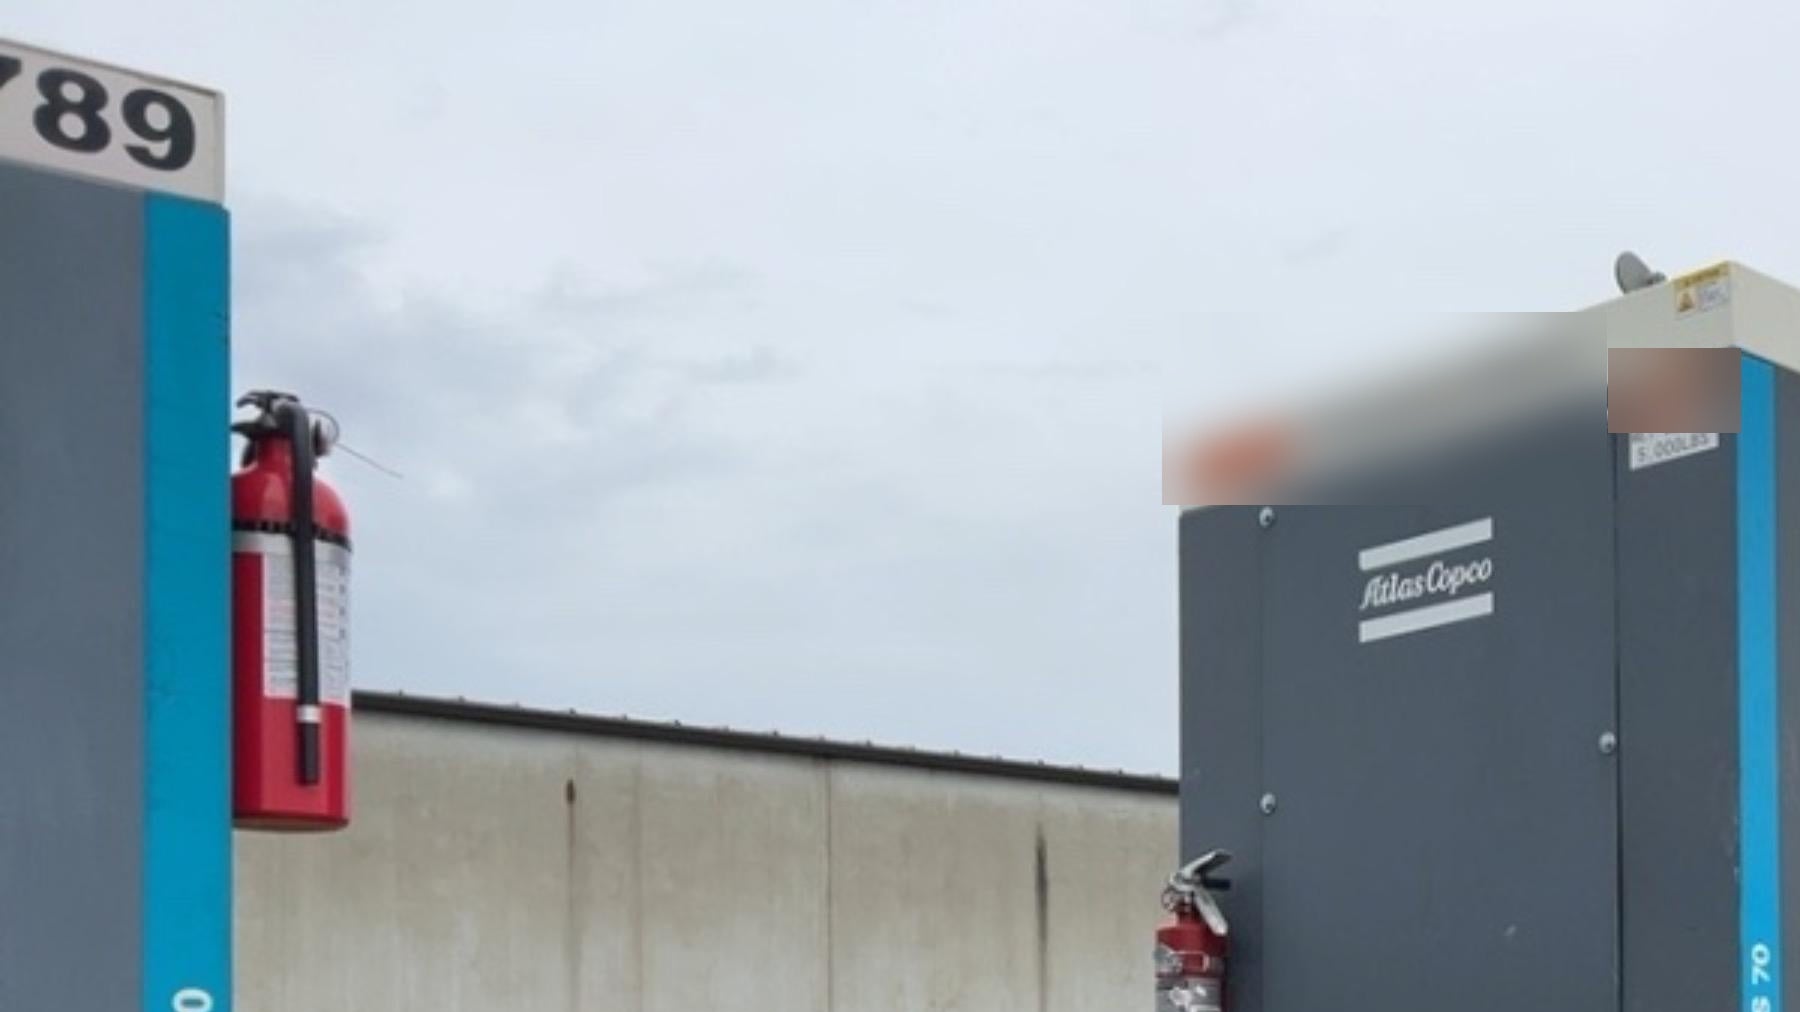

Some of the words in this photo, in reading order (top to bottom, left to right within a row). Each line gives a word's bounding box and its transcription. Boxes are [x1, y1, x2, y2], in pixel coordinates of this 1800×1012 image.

[1359, 572, 1425, 611] Atlas
[1426, 557, 1493, 595] Copco
[1751, 942, 1771, 985] 70
